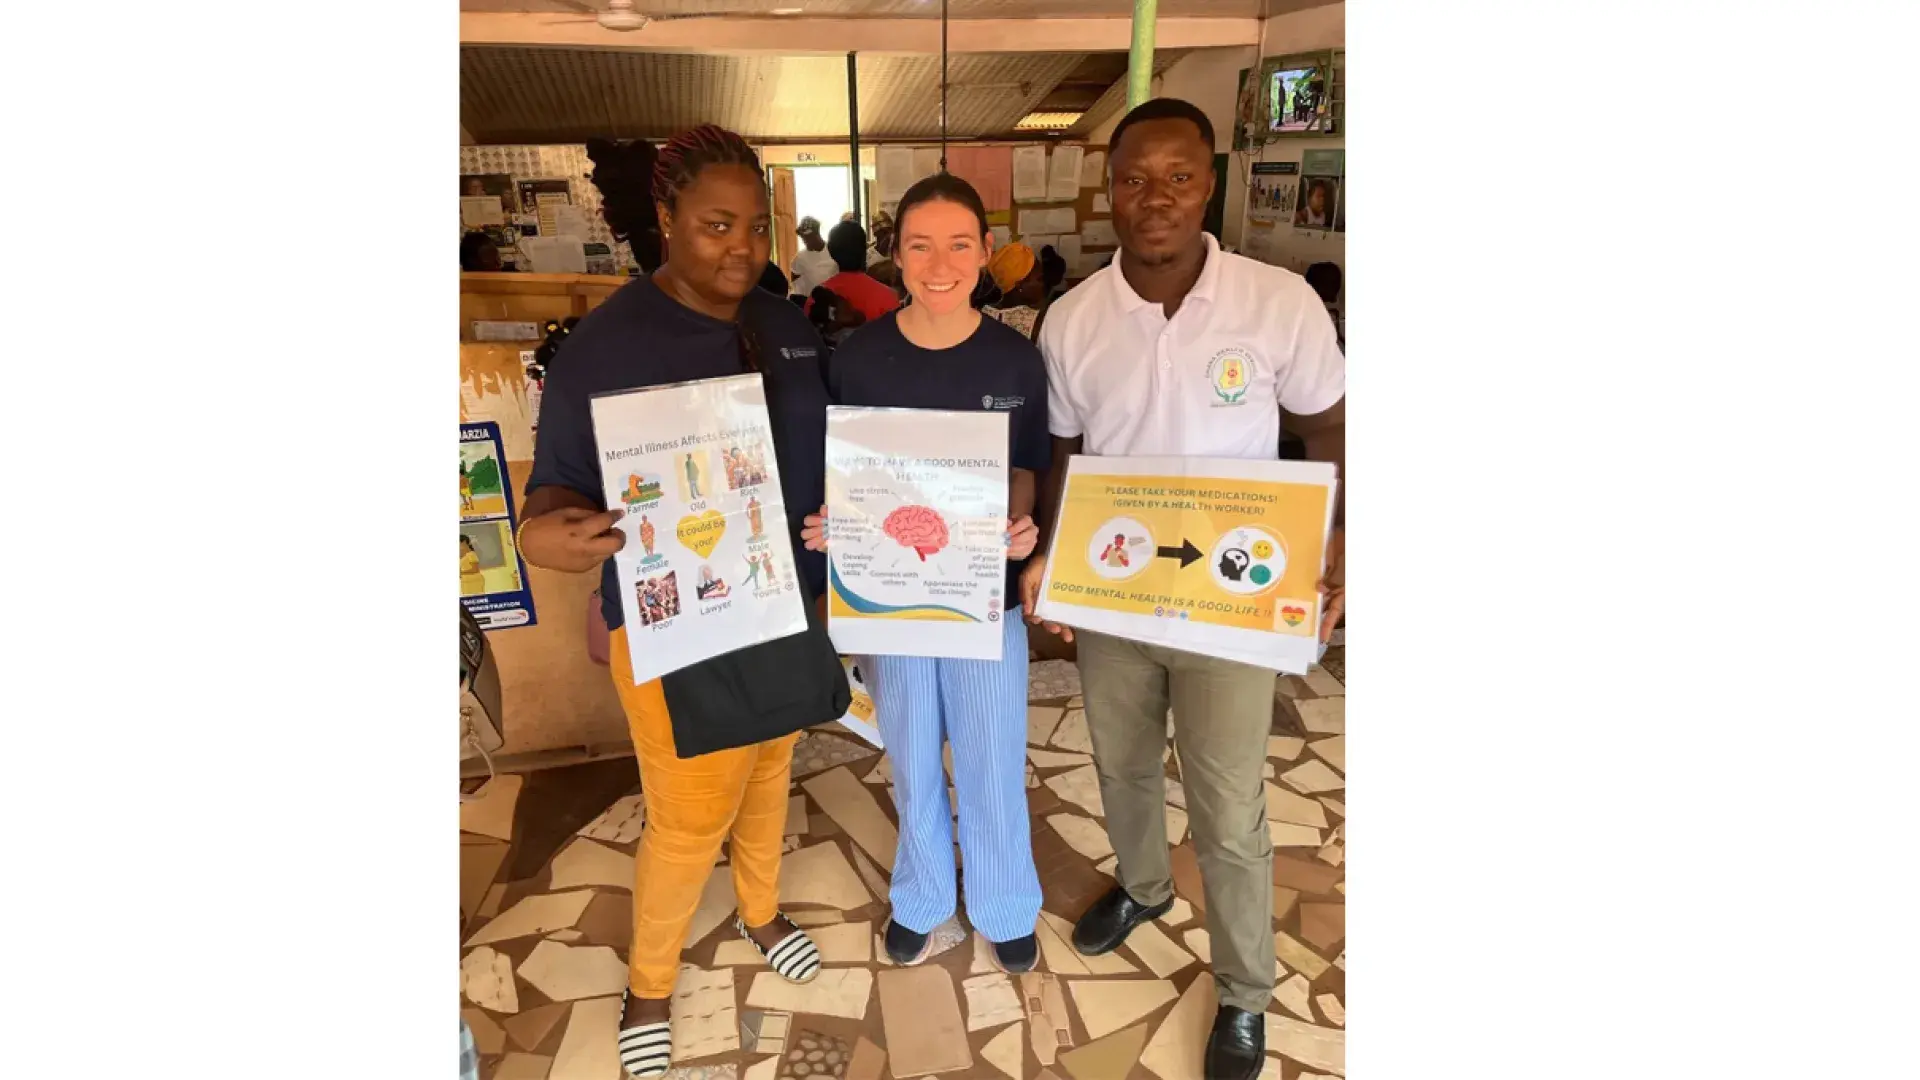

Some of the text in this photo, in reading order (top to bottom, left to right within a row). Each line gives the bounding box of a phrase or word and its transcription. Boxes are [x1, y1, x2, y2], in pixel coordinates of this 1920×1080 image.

[606, 445, 643, 462] Mental
[645, 439, 678, 454] Illness
[681, 432, 717, 447] Affects
[921, 458, 955, 467] GOOD
[957, 458, 1000, 468] MENTAL
[740, 487, 760, 498] Rich
[1105, 486, 1278, 503] PLEASE TAKE YOUR MEDICATIONS!
[627, 501, 659, 514] Farmer
[690, 501, 706, 512] Old
[1113, 499, 1145, 508] (GIVEN
[1148, 500, 1160, 508] BY
[1171, 501, 1212, 511] HEALTH
[1214, 504, 1265, 516] WORKER)
[686, 522, 713, 536] could
[713, 520, 726, 528] be
[748, 543, 769, 552] Male
[842, 553, 874, 562] Develop
[636, 559, 669, 575] Female
[968, 563, 1000, 571] physical
[902, 570, 919, 578] with
[882, 579, 907, 588] others
[753, 586, 781, 600] Young
[948, 588, 971, 598] things
[1052, 581, 1084, 594] GOOD
[1085, 586, 1126, 600] MENTAL
[1129, 592, 1171, 605] HEALTH
[1173, 597, 1184, 606] IS
[1186, 598, 1195, 607] A
[1198, 600, 1233, 613] GOOD
[1235, 605, 1260, 617] LIFE
[700, 600, 732, 616] Lawyer
[652, 620, 674, 632] Poor
